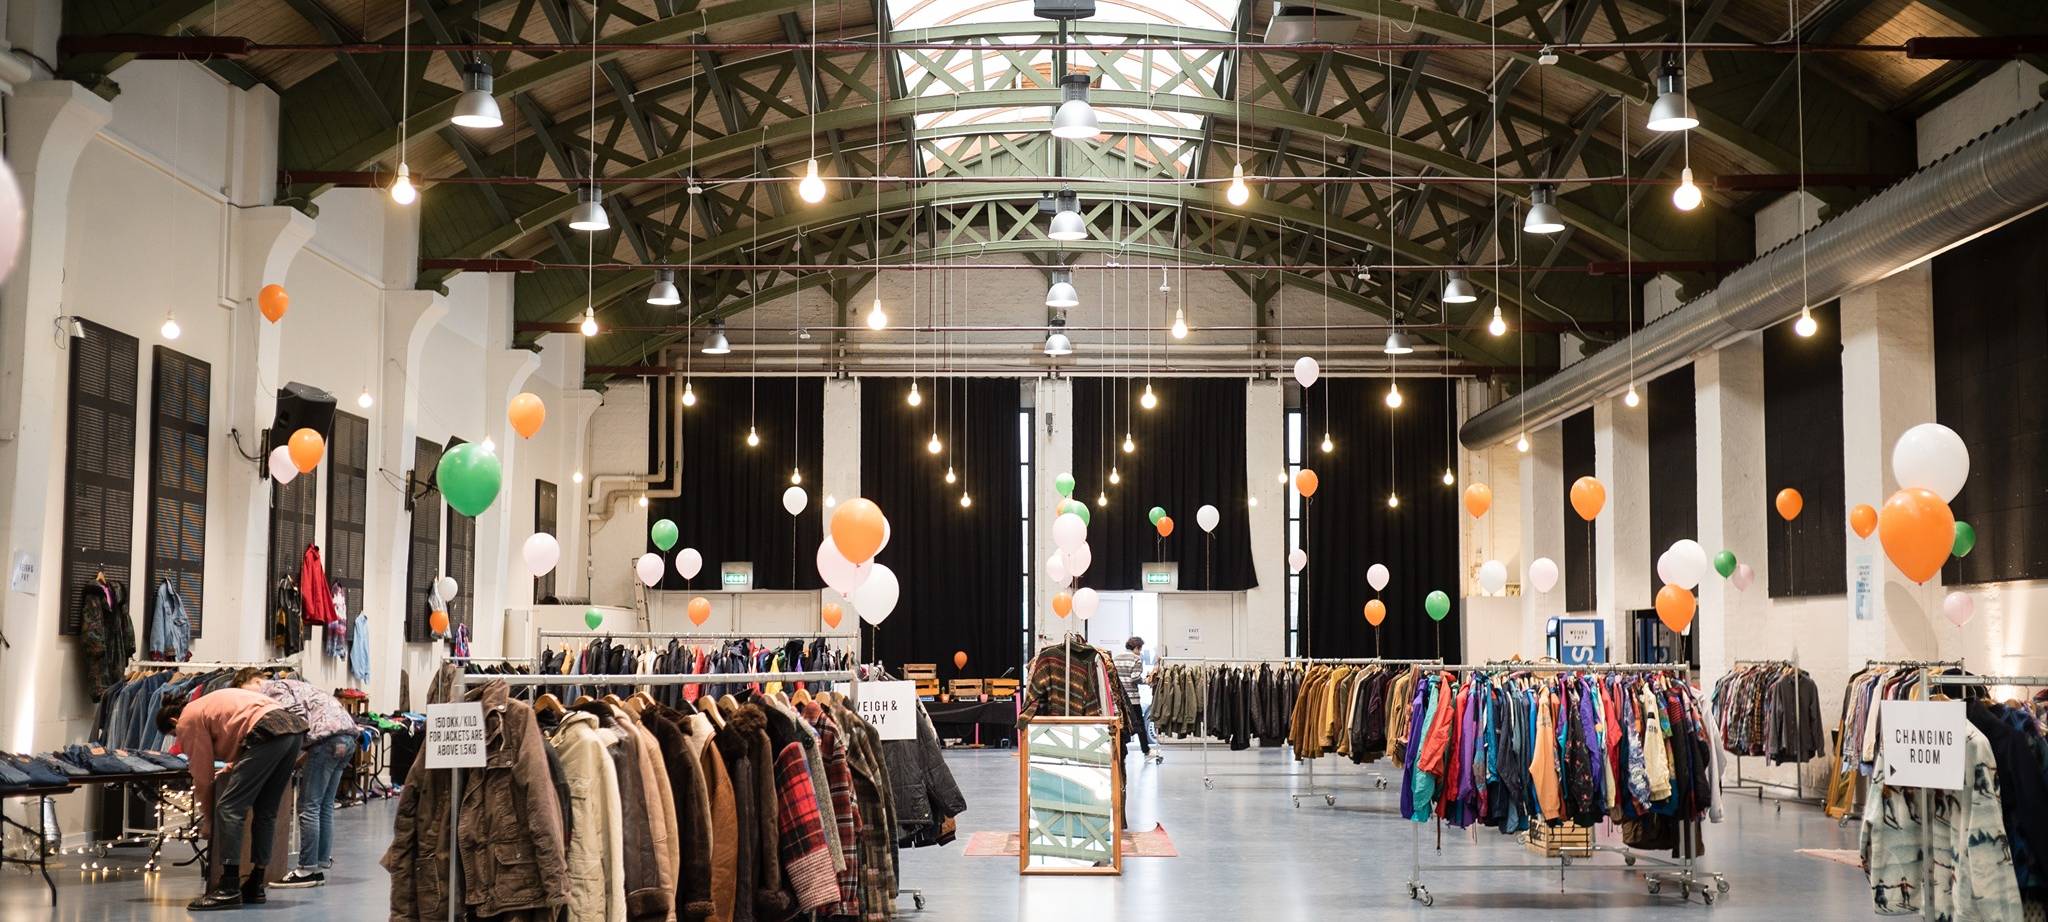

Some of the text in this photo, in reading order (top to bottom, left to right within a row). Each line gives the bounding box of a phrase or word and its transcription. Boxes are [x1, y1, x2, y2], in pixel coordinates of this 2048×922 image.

[435, 717, 446, 728] 150
[447, 717, 458, 728] DKK
[464, 715, 477, 727] KILO
[429, 729, 483, 742] FOR JACKETS ARE
[1895, 729, 1953, 746] CHANGING
[437, 744, 459, 756] ABOVE
[1910, 748, 1941, 764] ROOM
